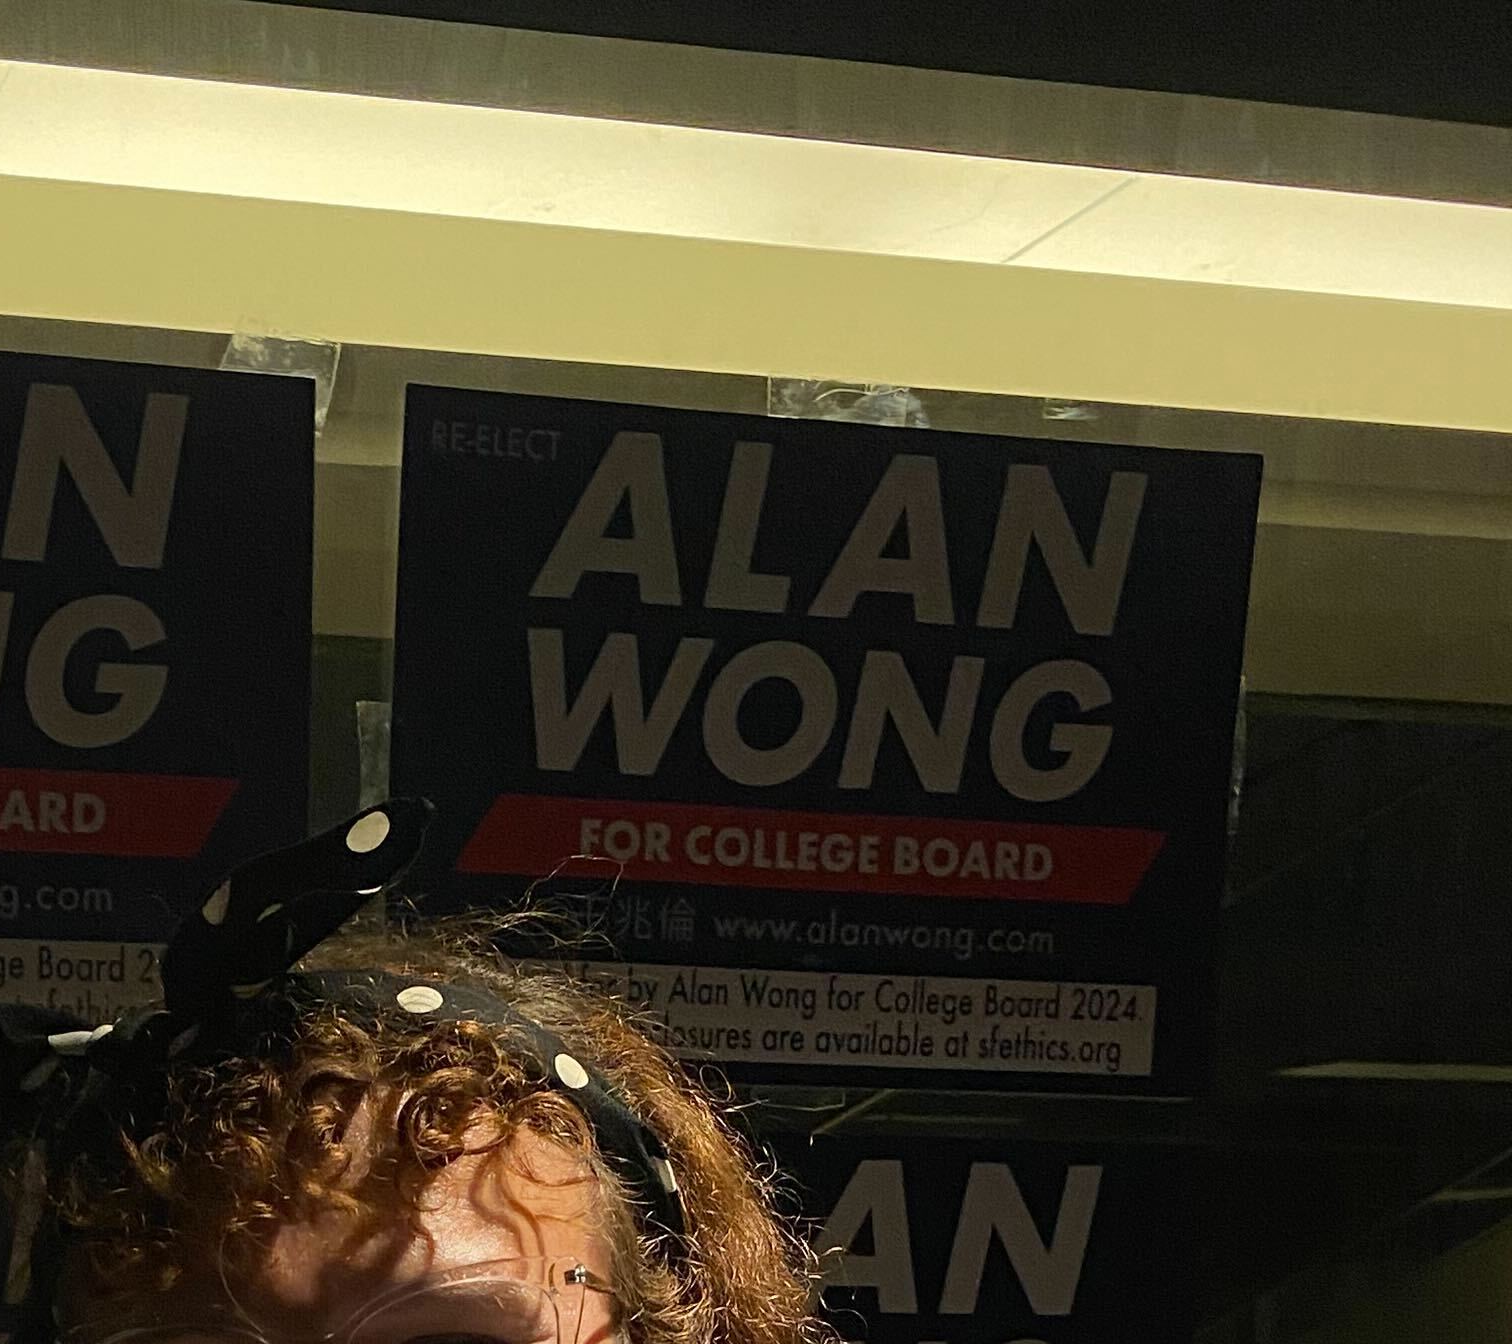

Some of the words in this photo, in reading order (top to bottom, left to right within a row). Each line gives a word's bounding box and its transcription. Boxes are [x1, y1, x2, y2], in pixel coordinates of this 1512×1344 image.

[432, 420, 561, 462] RE-ELECT
[528, 429, 1149, 637] ALAN
[528, 626, 1113, 802] WONG
[579, 817, 672, 866] FOR
[685, 825, 881, 876] COLLEGE
[893, 833, 1055, 882] BOARD
[712, 908, 1056, 959] www.alanwong.com
[38, 945, 126, 982] Board
[627, 965, 658, 1007] by
[668, 968, 729, 1006] Alan
[740, 972, 818, 1019] Wong
[827, 974, 865, 1011] for
[876, 977, 973, 1021] College
[985, 982, 1061, 1021] Board
[1072, 986, 1143, 1023] 2024.
[762, 1022, 805, 1053] are
[815, 1018, 934, 1057] available
[946, 1027, 970, 1059] at
[978, 1025, 1123, 1071] sfethics.org
[806, 1158, 1104, 1316] AN
